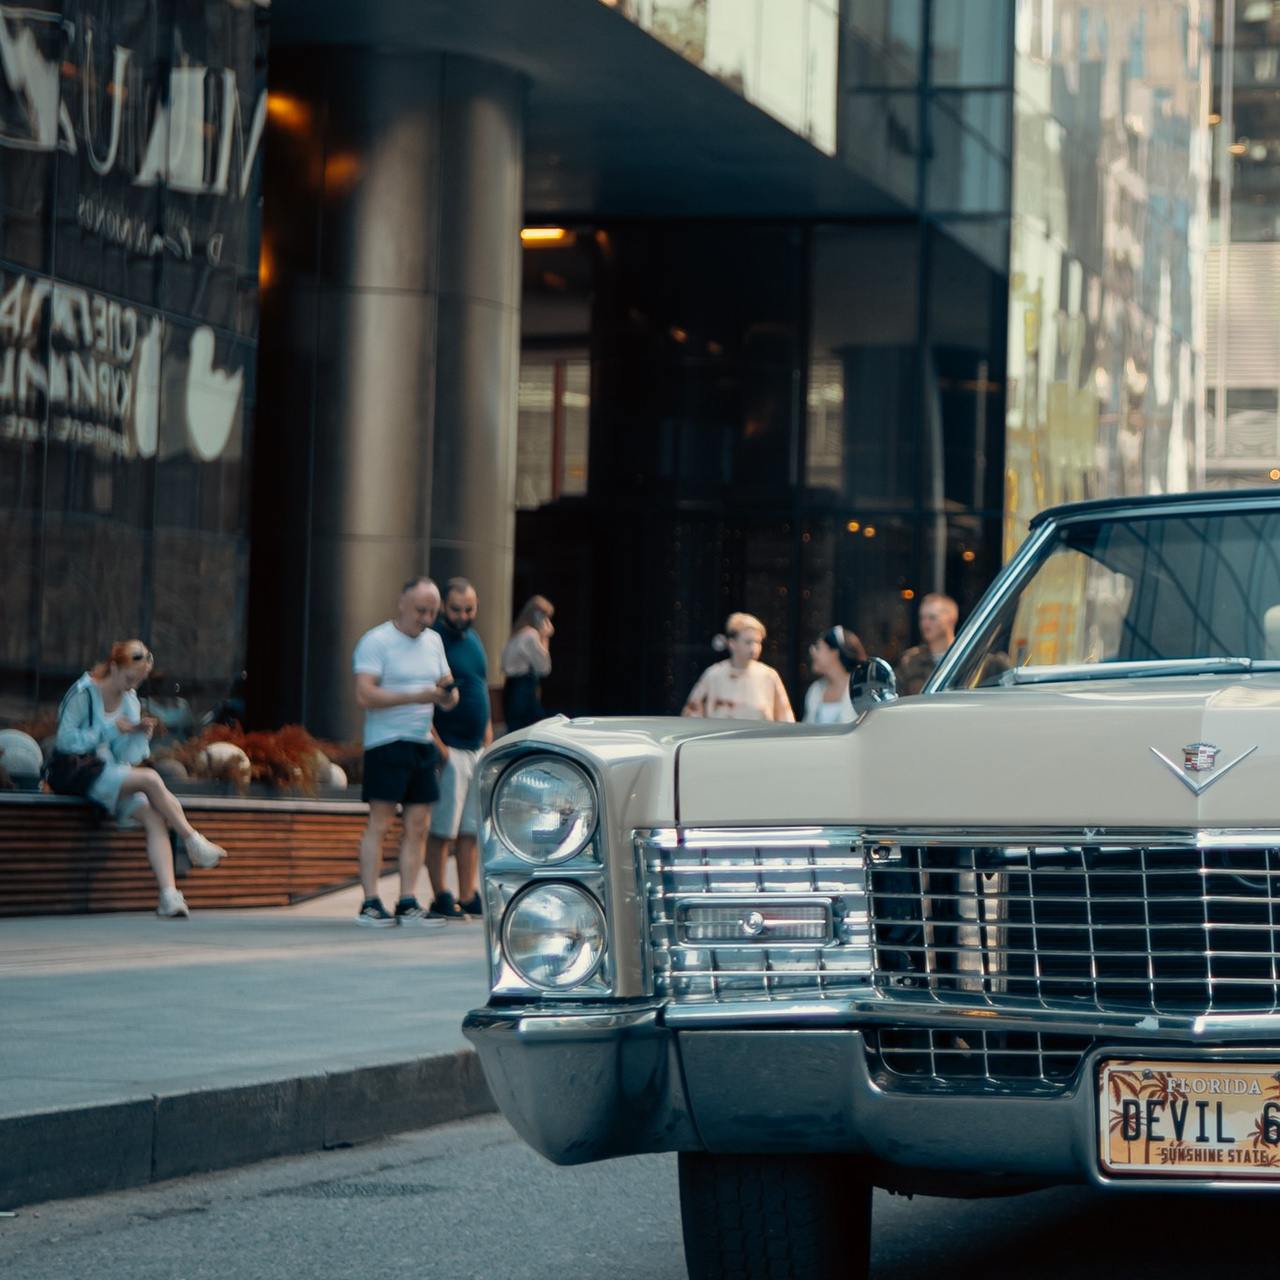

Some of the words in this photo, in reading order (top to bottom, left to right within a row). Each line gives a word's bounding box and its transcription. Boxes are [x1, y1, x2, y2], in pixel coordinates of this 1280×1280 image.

[1166, 1077, 1262, 1095] FLORIDA
[1122, 1099, 1235, 1143] DEVIL
[1161, 1147, 1223, 1162] SUNSHINE
[1228, 1149, 1268, 1163] STATE
